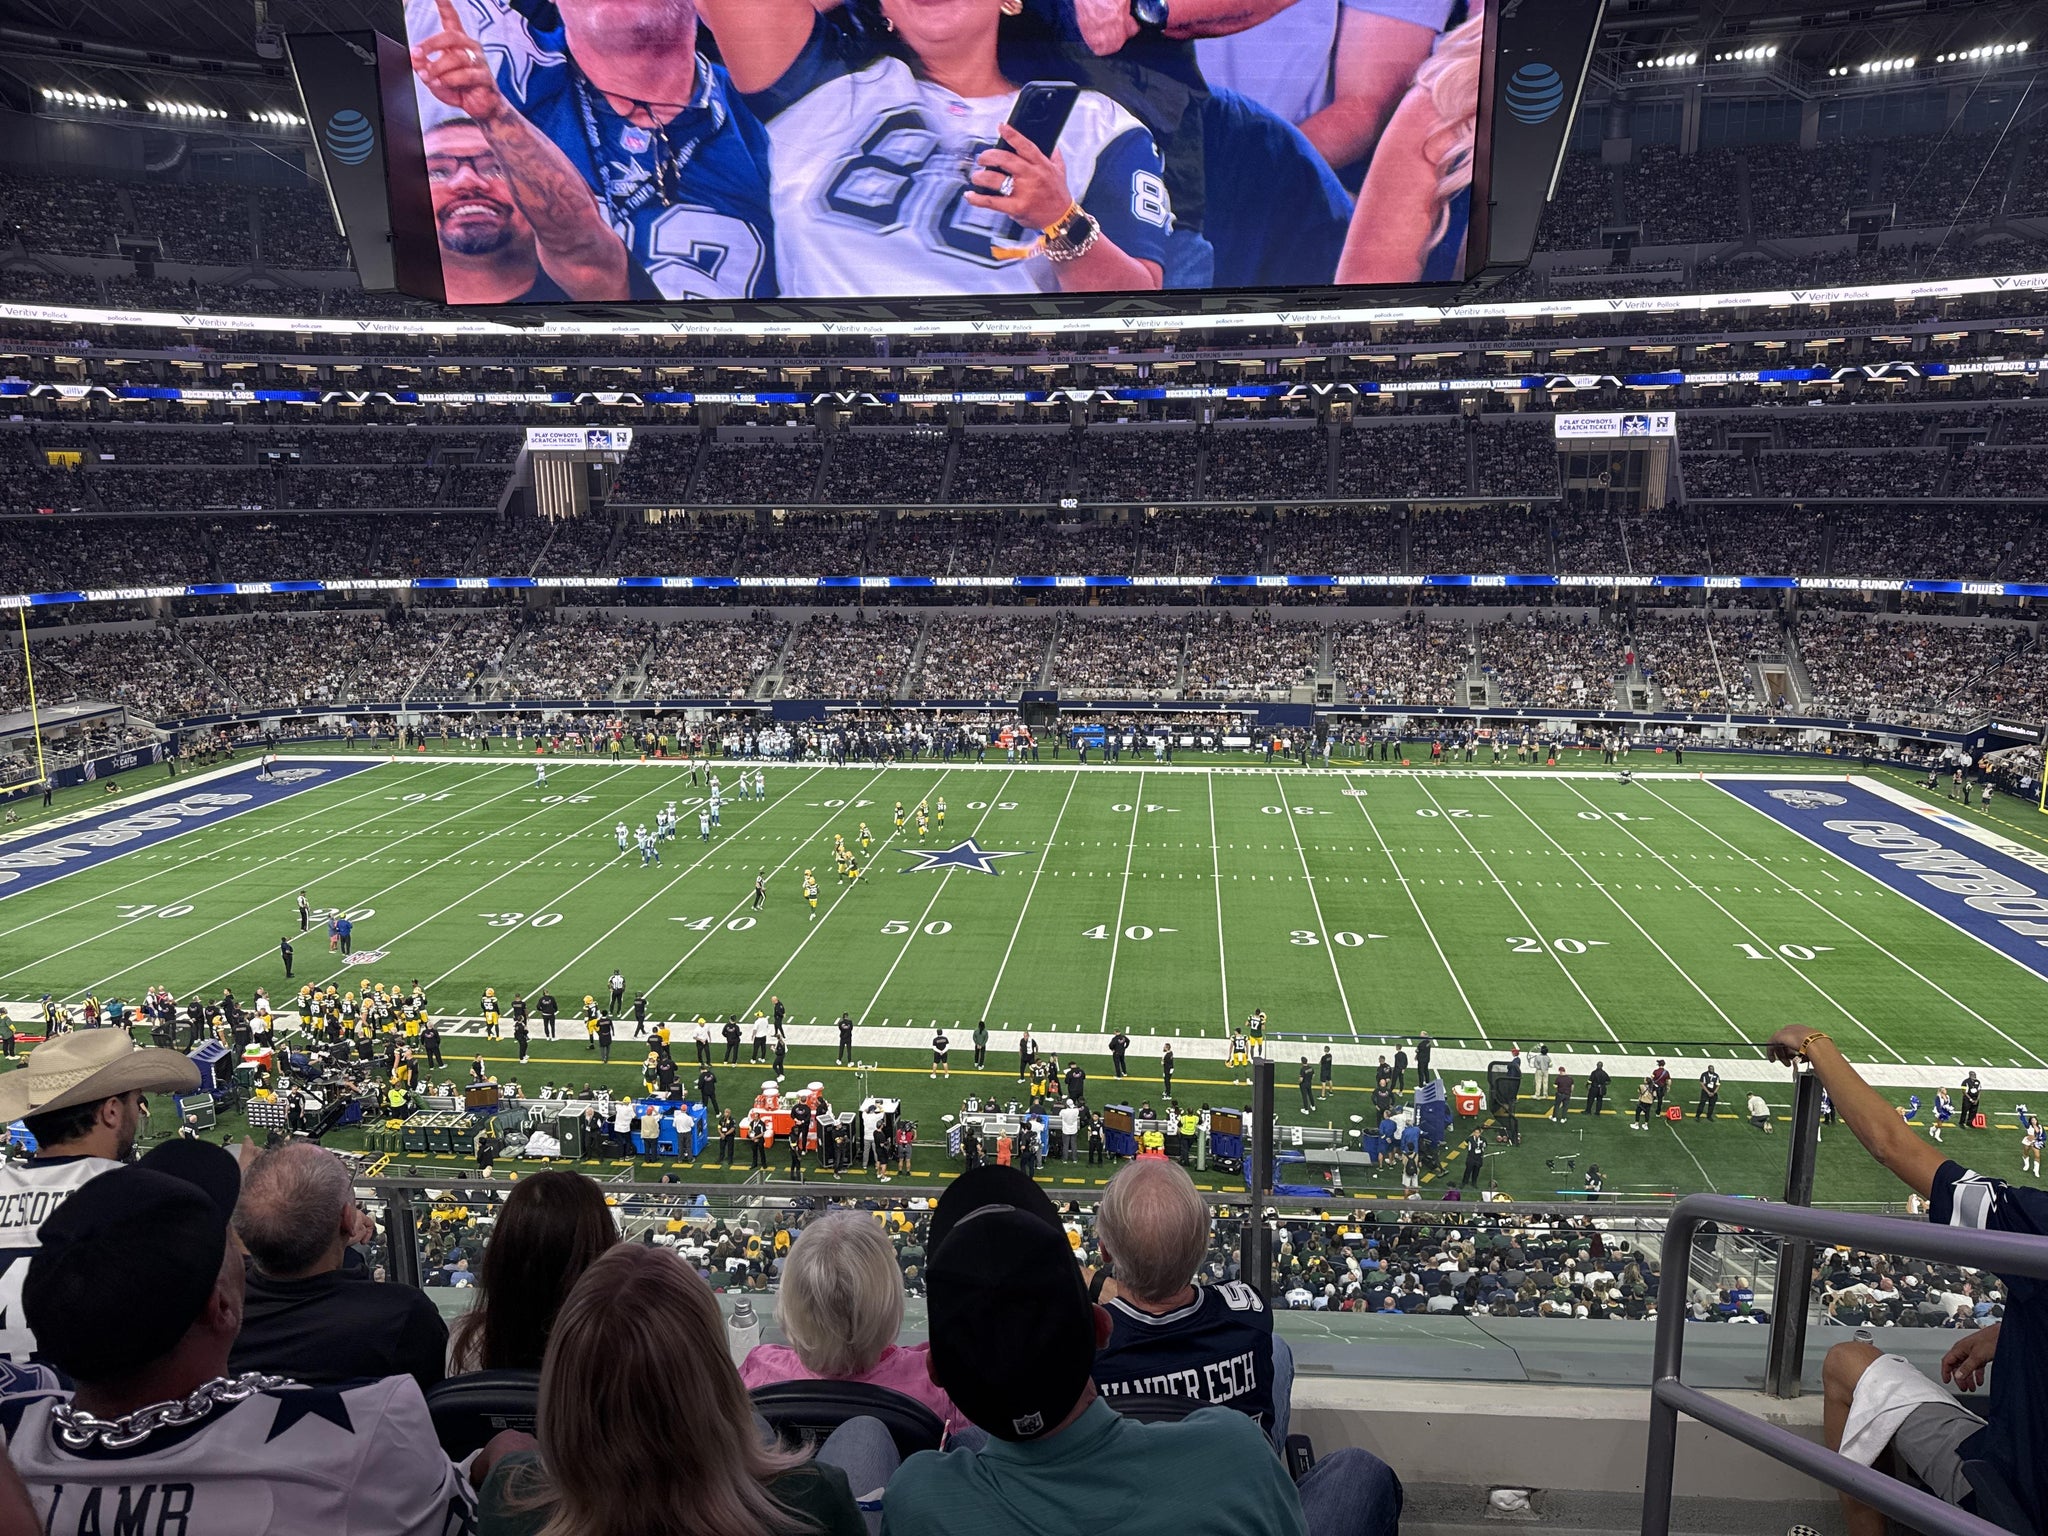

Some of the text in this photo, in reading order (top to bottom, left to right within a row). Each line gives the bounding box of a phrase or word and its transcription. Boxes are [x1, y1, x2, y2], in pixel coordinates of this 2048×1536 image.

[1132, 169, 1171, 228] 8
[2013, 277, 2048, 287] Veritiv
[1809, 291, 1870, 300] Veritiv Pollock
[1625, 301, 1653, 309] Veritiv
[6, 307, 68, 319] Veritiv Pollock
[1454, 308, 1480, 316] Veritiv
[198, 319, 227, 327] Veritiv
[1291, 314, 1317, 322] Veritiv
[1667, 335, 1696, 343] LANDRY
[16, 346, 54, 354] RAYFIELD
[57, 347, 88, 355] WRIGHT
[1949, 363, 1983, 373] DALLAS
[1983, 361, 2025, 371] COWBOYS
[1739, 372, 1759, 381] 2025
[326, 579, 411, 590] EARN YOUR SUNDAY
[538, 578, 619, 586] EARN YOUR SUNDAY
[740, 577, 819, 586] EARN YOUR SUNDAY
[936, 577, 1013, 586] EARN YOUR SUNDAY
[1133, 577, 1213, 586] EARN YOUR SUNDAY
[1338, 576, 1425, 585] EARN YOUR SUNDAY
[1560, 576, 1654, 586] EARN YOUR SUNDAY
[1801, 578, 1905, 590] EARN YOUR SUNDAY
[88, 587, 186, 600] EARN YOUR SUNDAY
[0, 595, 32, 608] OW'S
[1998, 723, 2038, 737] Blockchain.com
[120, 755, 138, 766] CATCH
[0, 793, 253, 884] WBOYS
[117, 904, 194, 919] 10
[487, 912, 564, 927] 30
[684, 916, 757, 931] 40
[880, 920, 953, 935] 50
[1081, 924, 1153, 941] 40
[1289, 930, 1365, 947] 30
[1505, 936, 1587, 954] 20
[1732, 943, 1816, 960] 10
[342, 1004, 351, 1013] 94
[591, 1007, 597, 1017] 7
[1250, 1020, 1259, 1030] 17
[1236, 1040, 1245, 1049] 19
[1035, 1069, 1044, 1077] 13
[967, 1101, 978, 1112] 10
[1009, 1105, 1016, 1114] 2
[1463, 1100, 1474, 1111] G
[1670, 1108, 1681, 1118] 20
[0, 1189, 76, 1228] ESOT
[1203, 1351, 1257, 1404] ESCH
